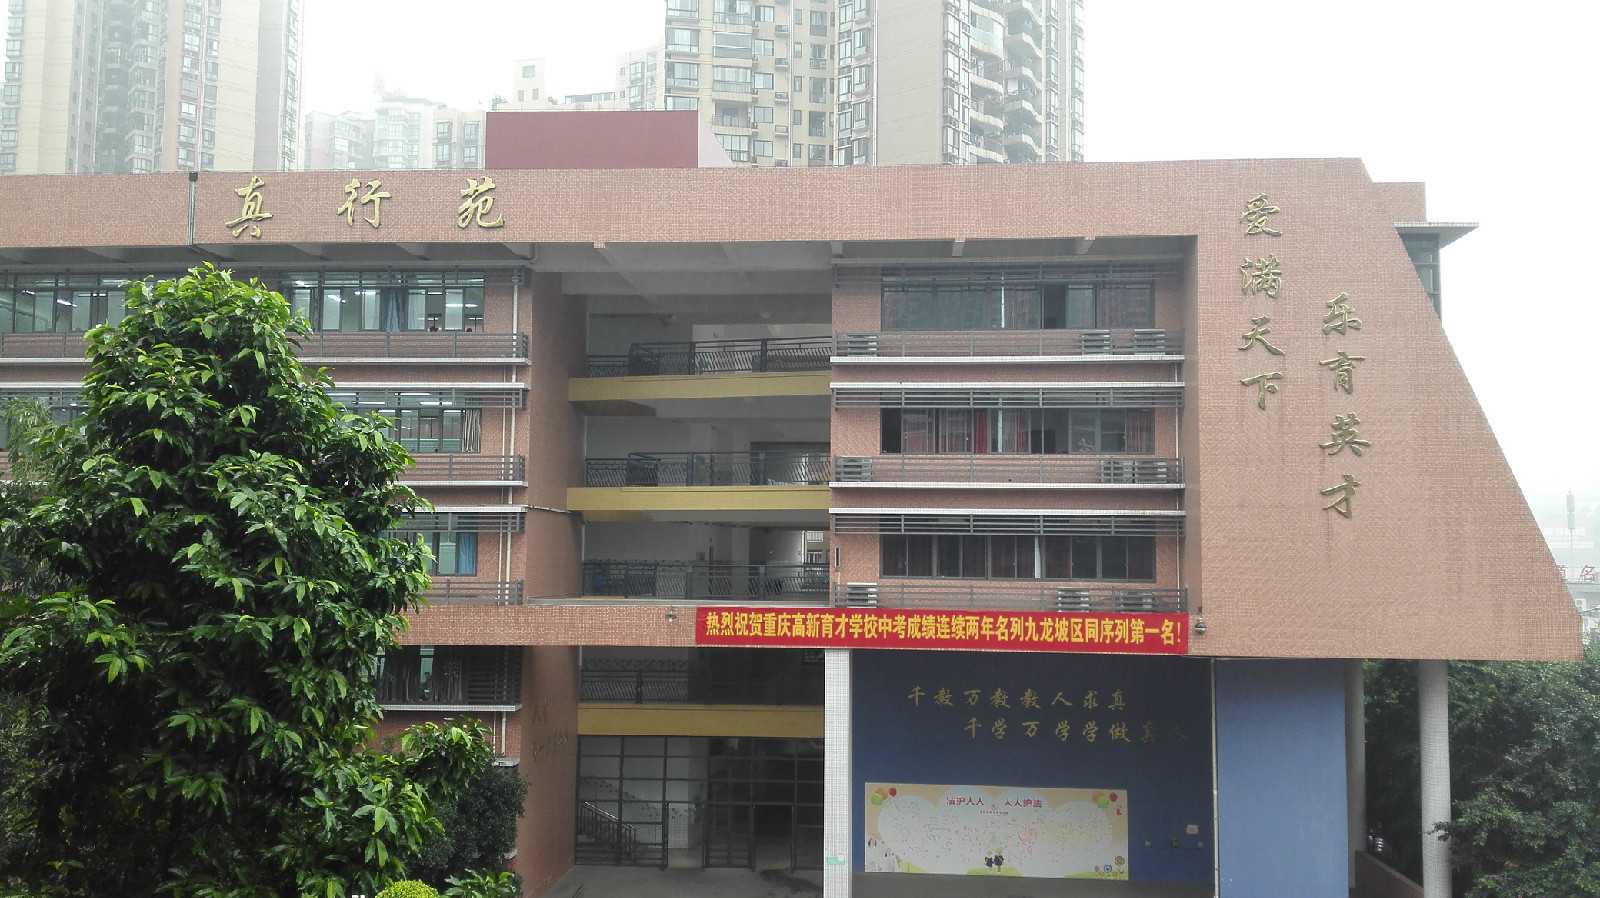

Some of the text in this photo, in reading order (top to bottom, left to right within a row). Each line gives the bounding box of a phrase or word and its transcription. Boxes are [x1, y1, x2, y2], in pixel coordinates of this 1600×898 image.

[225, 176, 505, 238] 真行苑
[1238, 193, 1285, 410] 爱满天下
[1318, 292, 1371, 518] 乐育英才
[705, 611, 1182, 646] 热烈祝贺重庆高新育才学校中考成绩连续两年名列九龙坡区同序列第一名!
[907, 686, 1126, 711] 千教万教教人求真
[1004, 798, 1043, 809] 人人护法
